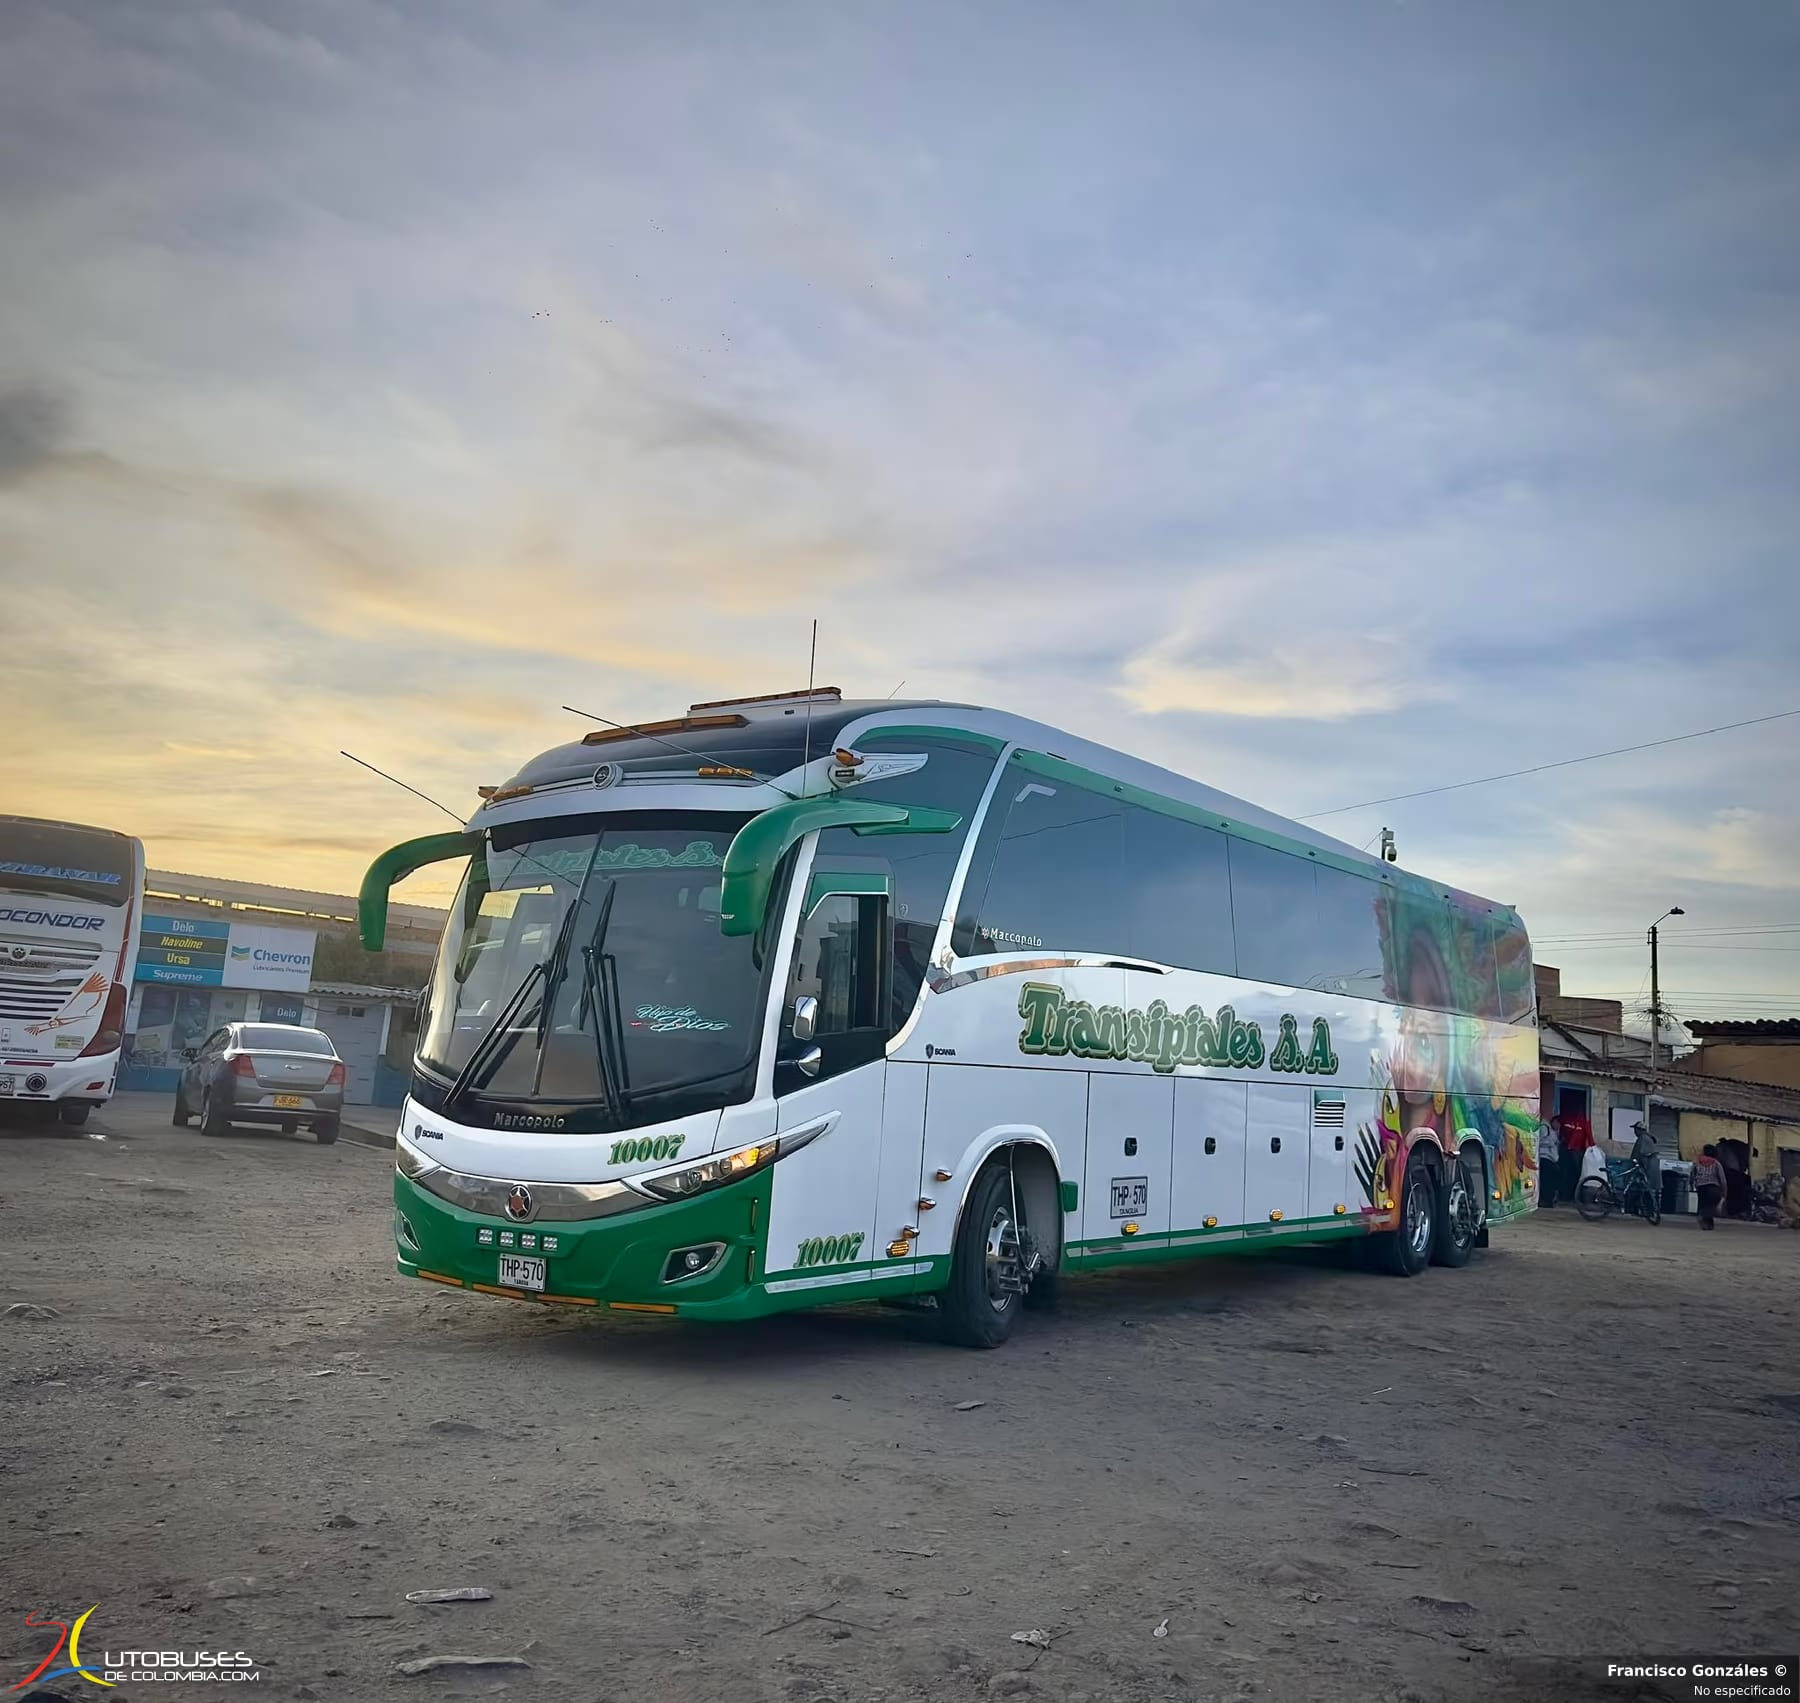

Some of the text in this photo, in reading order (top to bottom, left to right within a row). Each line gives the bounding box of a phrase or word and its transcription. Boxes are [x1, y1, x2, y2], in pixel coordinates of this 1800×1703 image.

[172, 920, 195, 933] Delo
[160, 936, 204, 950] Havoline
[166, 952, 191, 965] Ursa
[253, 949, 311, 965] Chevron
[153, 969, 204, 982] Supreme
[276, 1007, 297, 1018] Delo
[649, 1015, 730, 1032] Dios
[1018, 982, 1265, 1073] Transipiales
[934, 1047, 957, 1057] SCANIA
[493, 1112, 565, 1129] Marcopolo
[421, 1129, 444, 1141] SCANIA
[607, 1133, 686, 1166] 10007
[792, 1231, 865, 1268] 10007
[501, 1257, 544, 1282] THP-570
